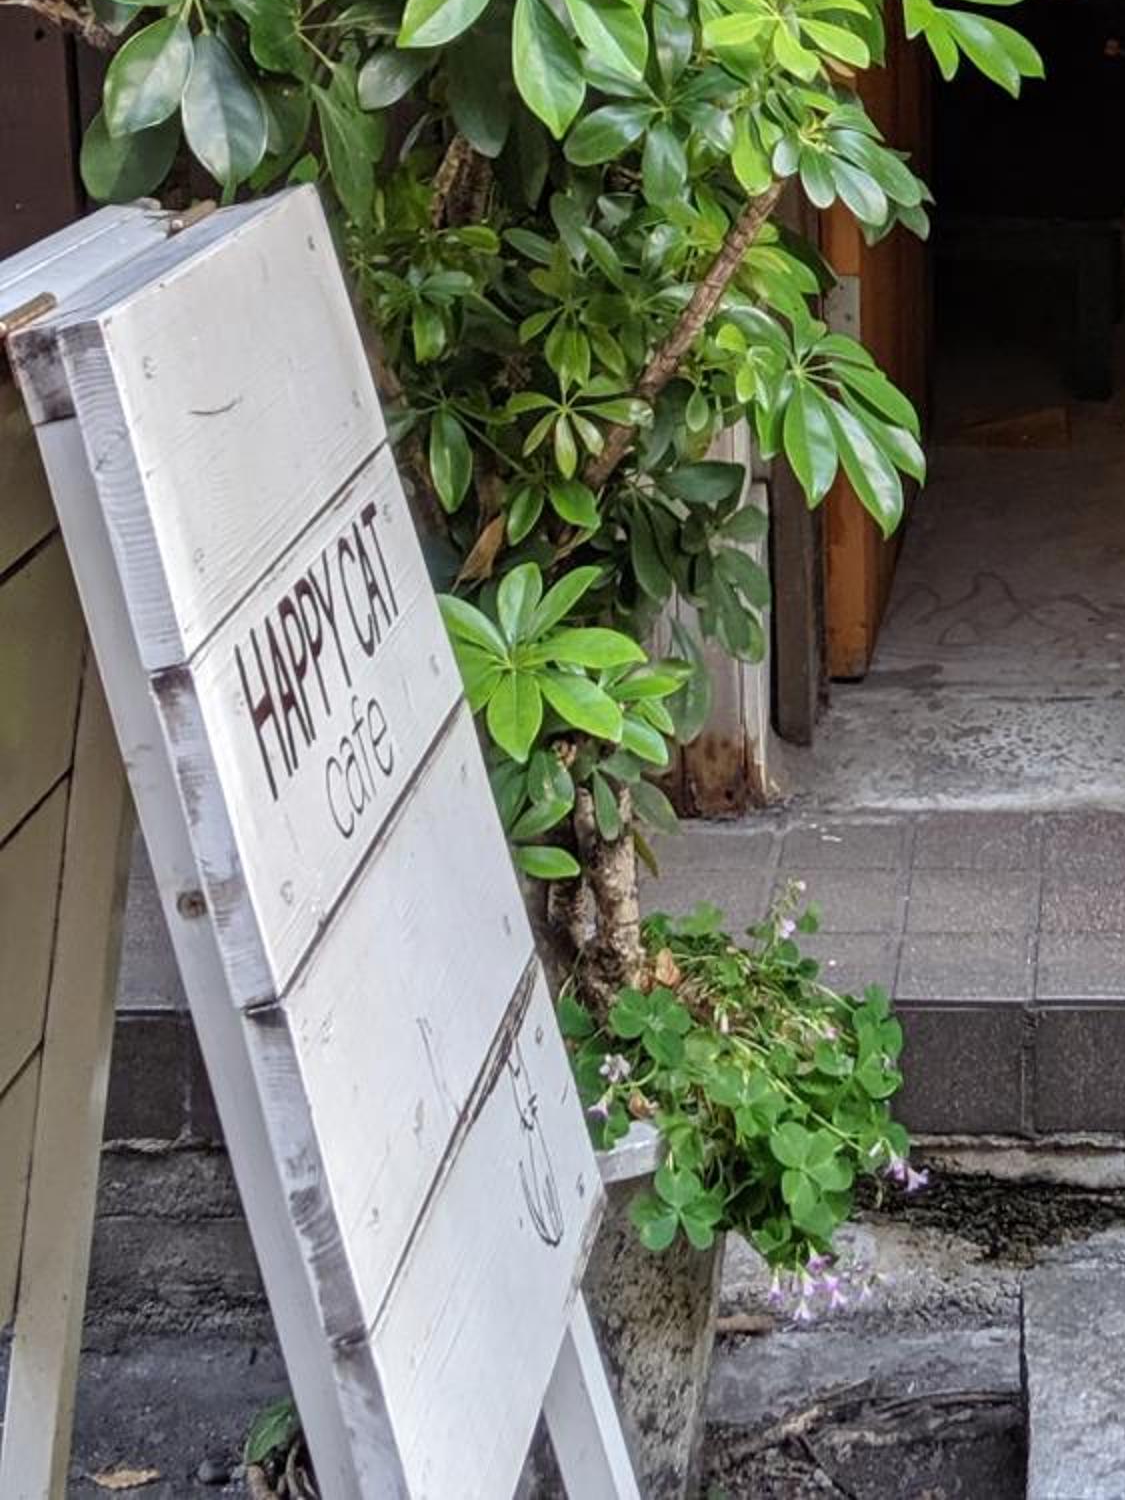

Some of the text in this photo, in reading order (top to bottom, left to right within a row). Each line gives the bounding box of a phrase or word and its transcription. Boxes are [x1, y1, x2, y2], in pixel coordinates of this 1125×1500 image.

[233, 500, 400, 802] HAPPY CAT
[323, 695, 396, 840] cafe
